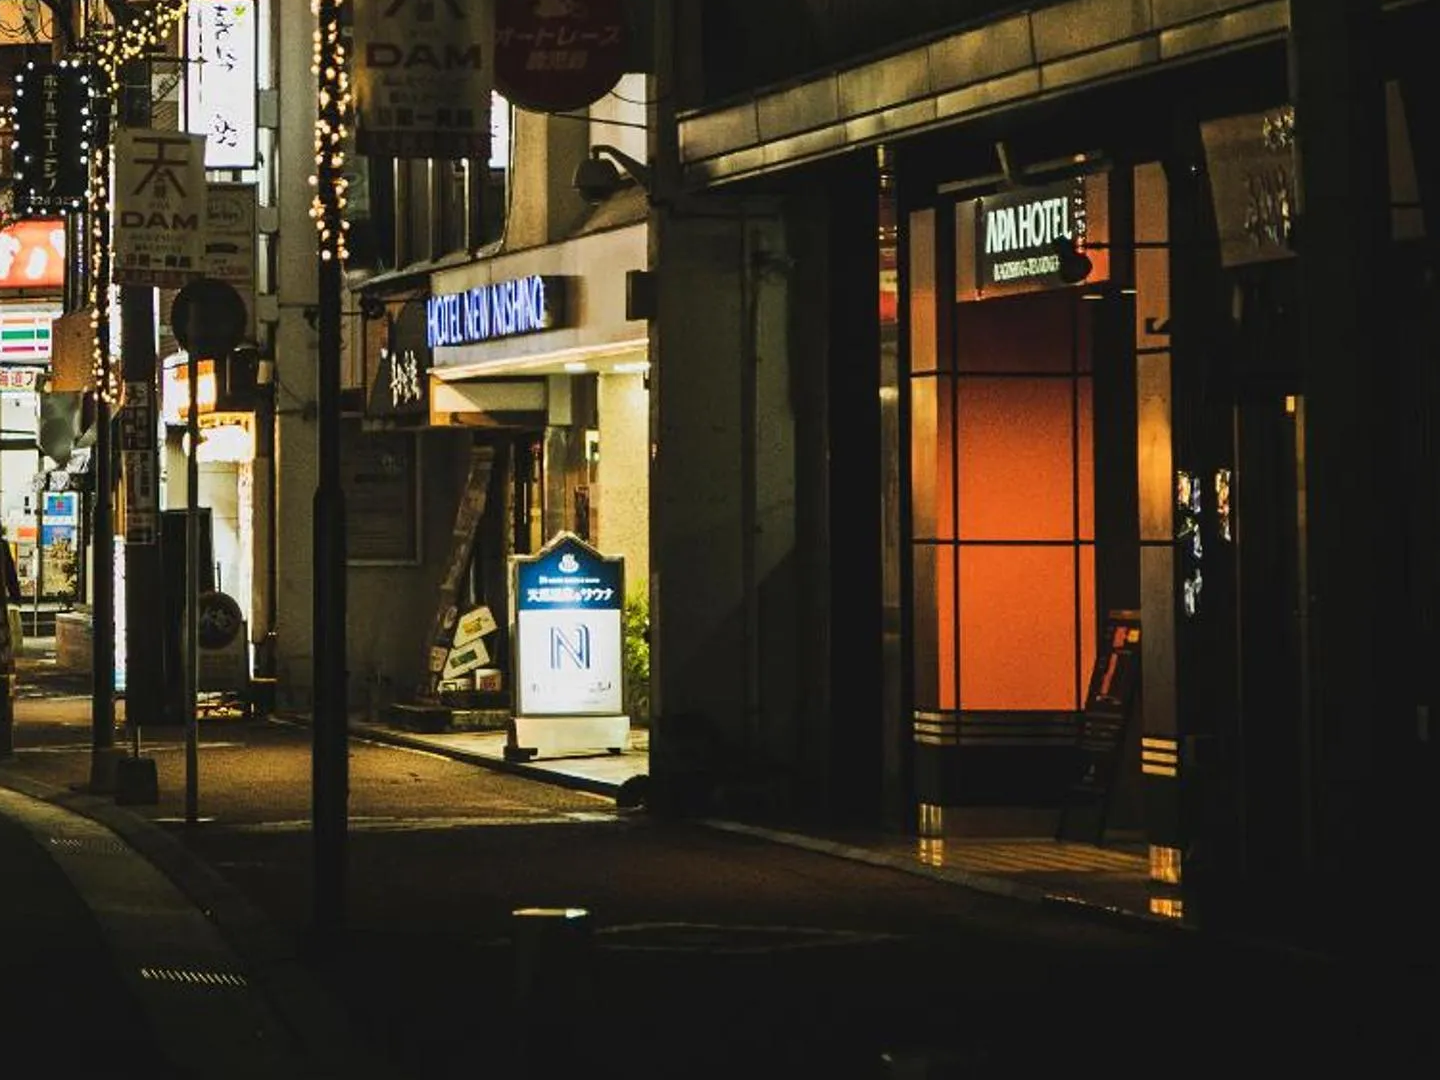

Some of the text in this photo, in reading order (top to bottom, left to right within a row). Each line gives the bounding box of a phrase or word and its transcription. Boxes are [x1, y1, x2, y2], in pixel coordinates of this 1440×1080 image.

[365, 42, 482, 69] DAM
[120, 211, 199, 231] DAM
[985, 196, 1073, 255] APA HOTEL
[426, 275, 546, 348] HOTEL NEW NISHINO
